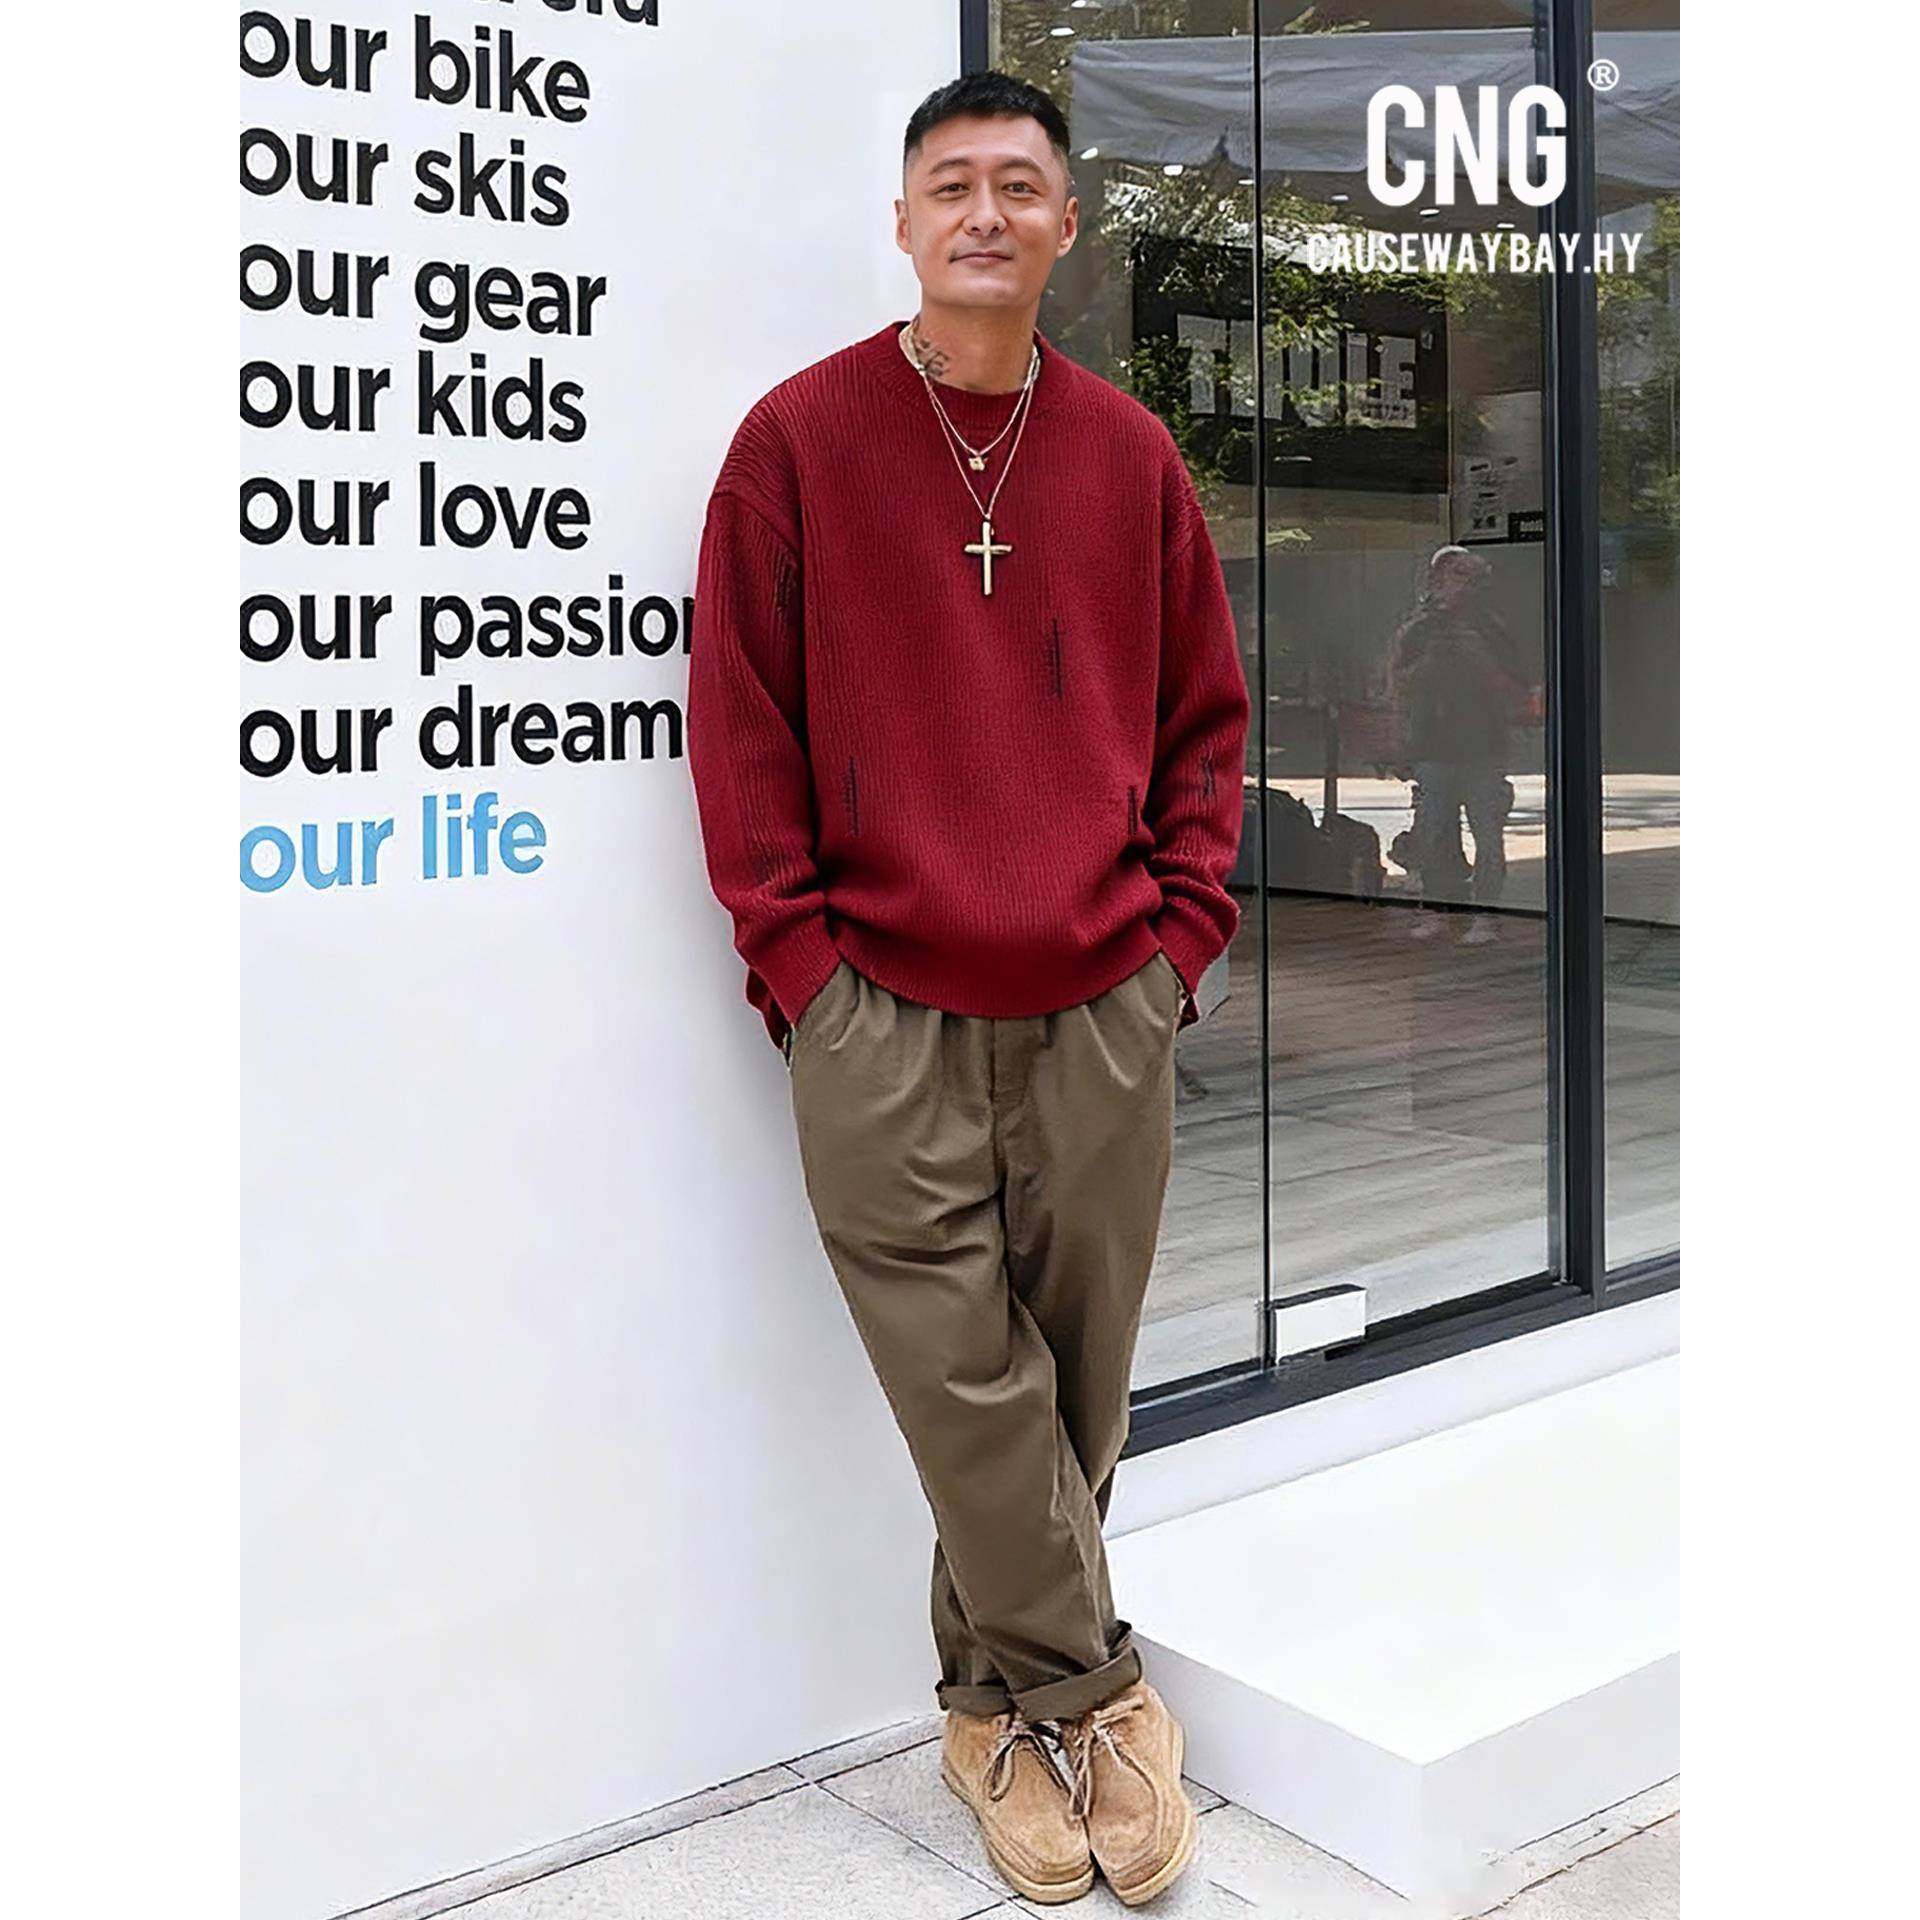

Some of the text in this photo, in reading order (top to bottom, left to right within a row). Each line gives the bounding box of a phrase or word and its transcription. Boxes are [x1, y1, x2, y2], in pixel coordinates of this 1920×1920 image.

[239, 9, 591, 124] our bike
[239, 127, 570, 227] our skis
[239, 243, 607, 344] our gear
[239, 348, 588, 444] our kids
[239, 460, 592, 551] our love
[239, 593, 393, 663] our
[239, 683, 684, 779] our dream
[239, 791, 547, 894] our life
